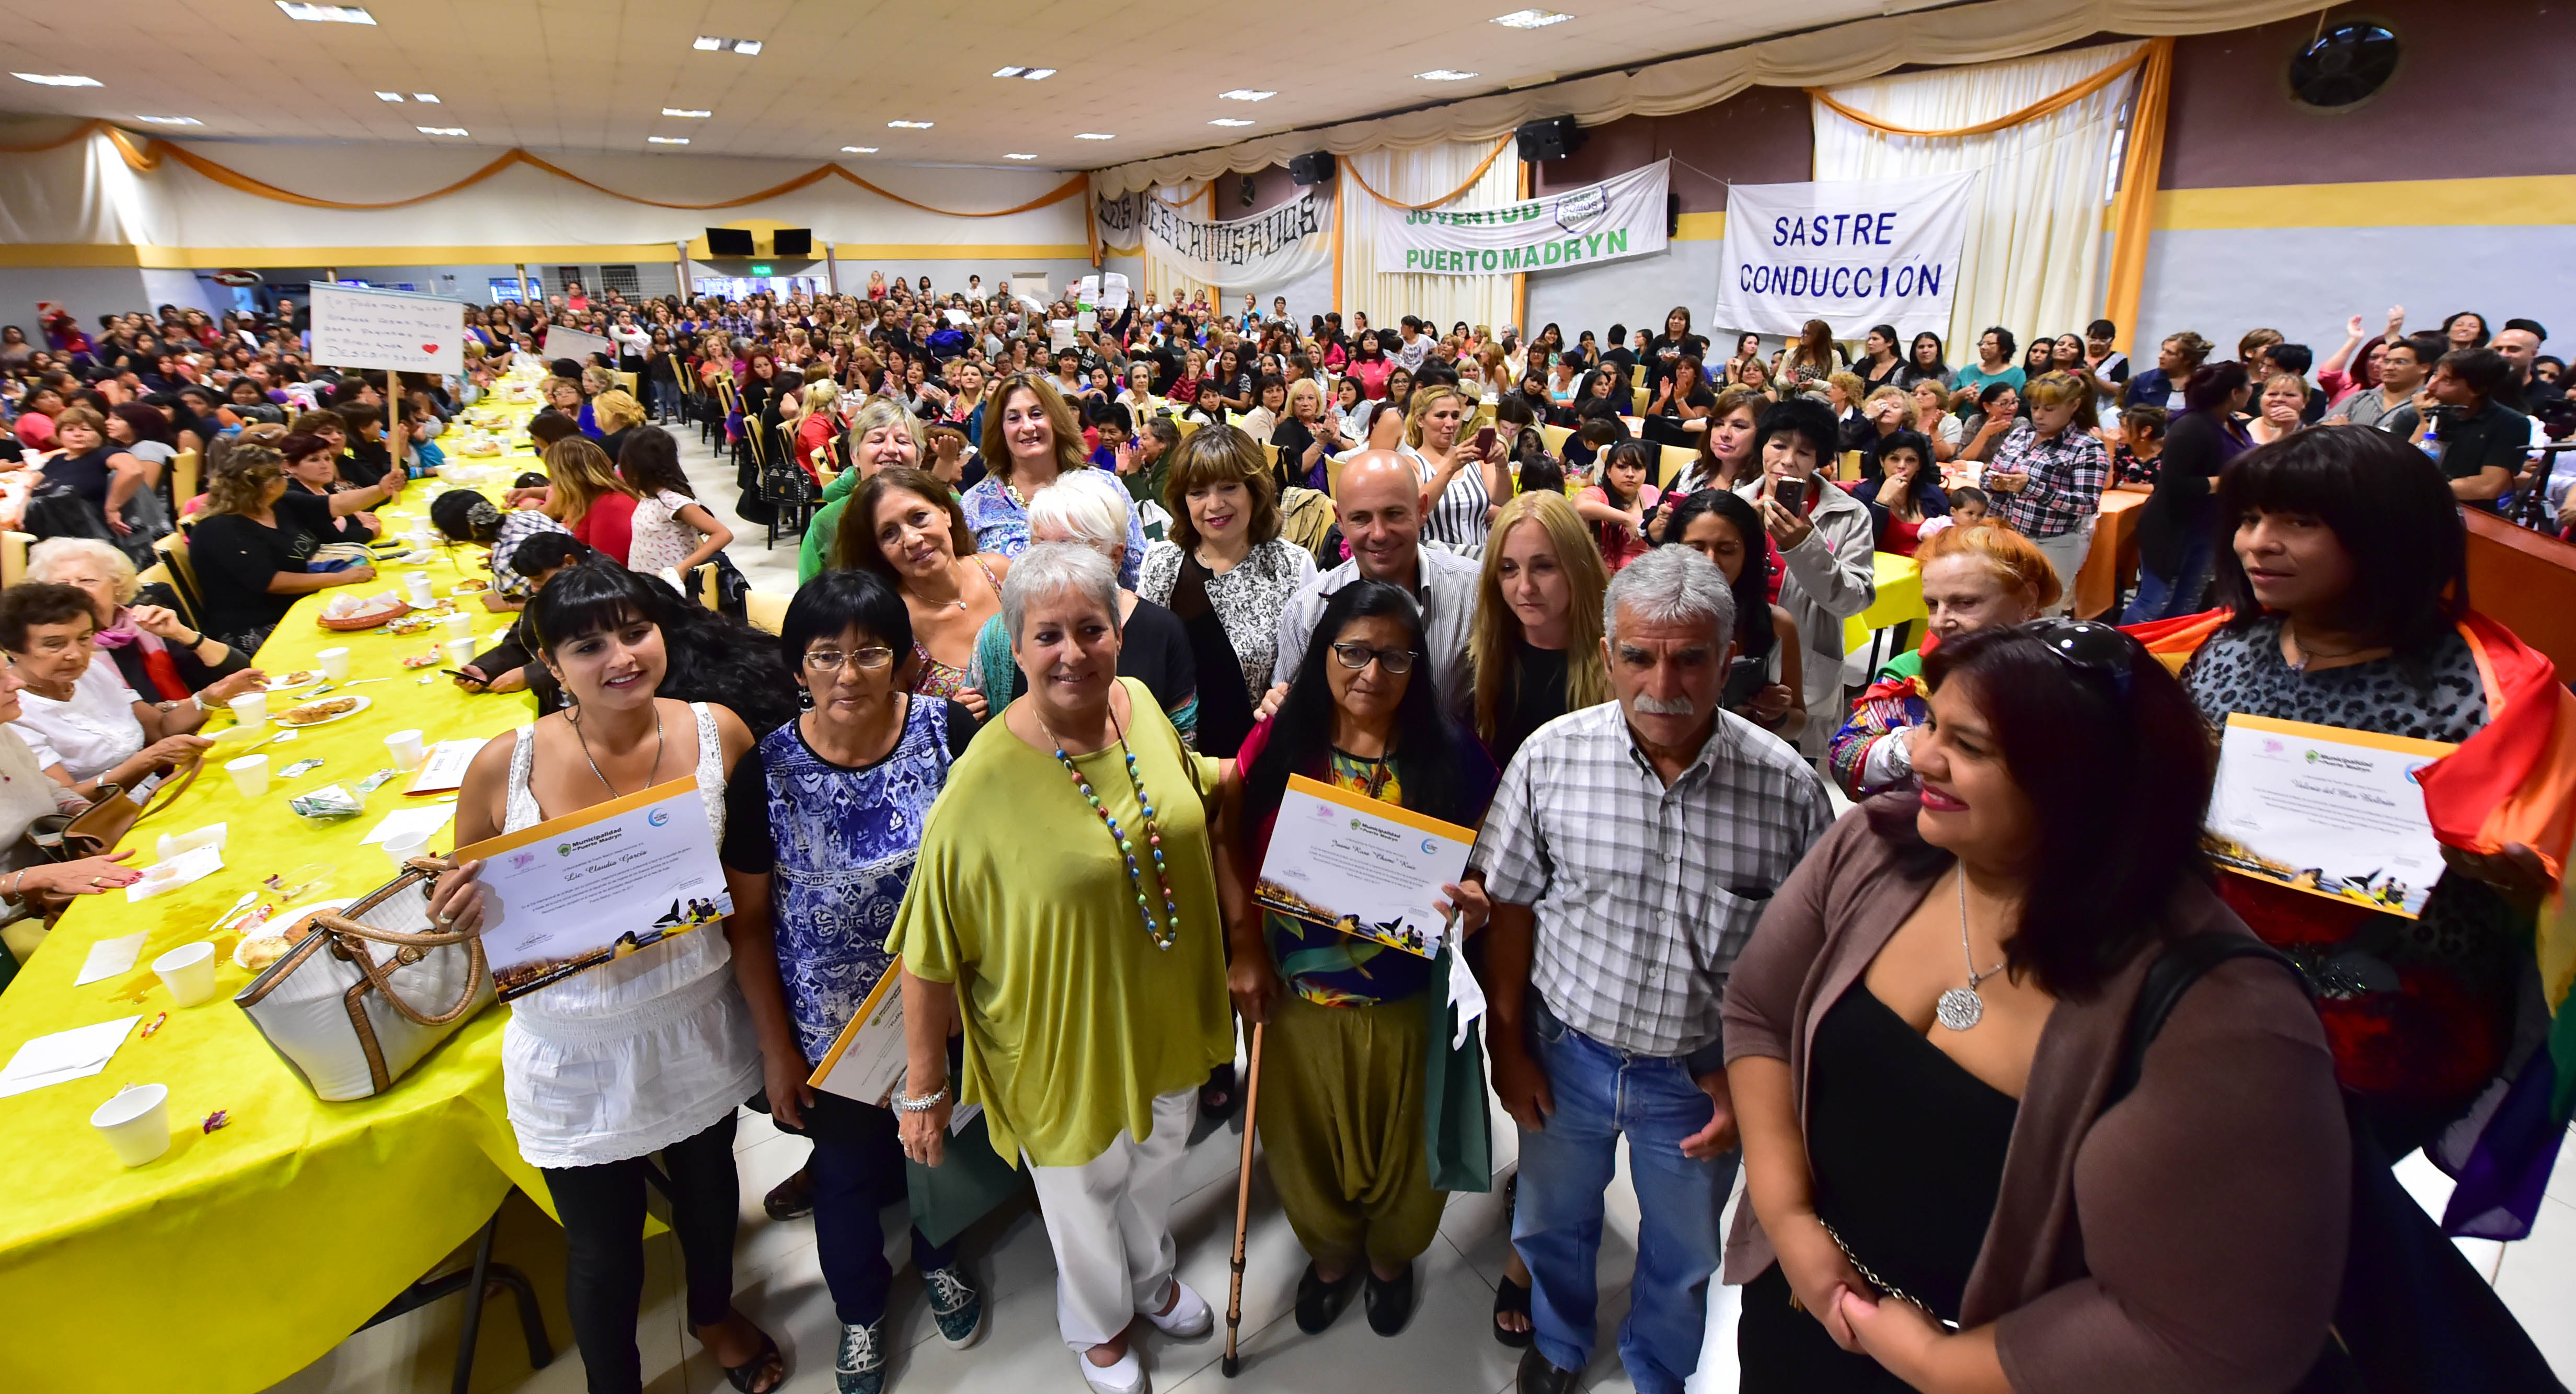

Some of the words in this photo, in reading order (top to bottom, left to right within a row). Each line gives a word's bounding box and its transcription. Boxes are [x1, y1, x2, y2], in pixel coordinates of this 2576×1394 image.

[1563, 201, 1597, 213] SOMOS
[1773, 212, 1898, 247] SASTRE
[1740, 254, 1942, 298] CONDUCCIÓN
[572, 827, 622, 848] Municipalidad
[577, 840, 598, 851] Puerto
[599, 833, 623, 846] Madryn
[585, 860, 617, 874] Claudia
[507, 965, 575, 994] www.madryn.gov.ar
